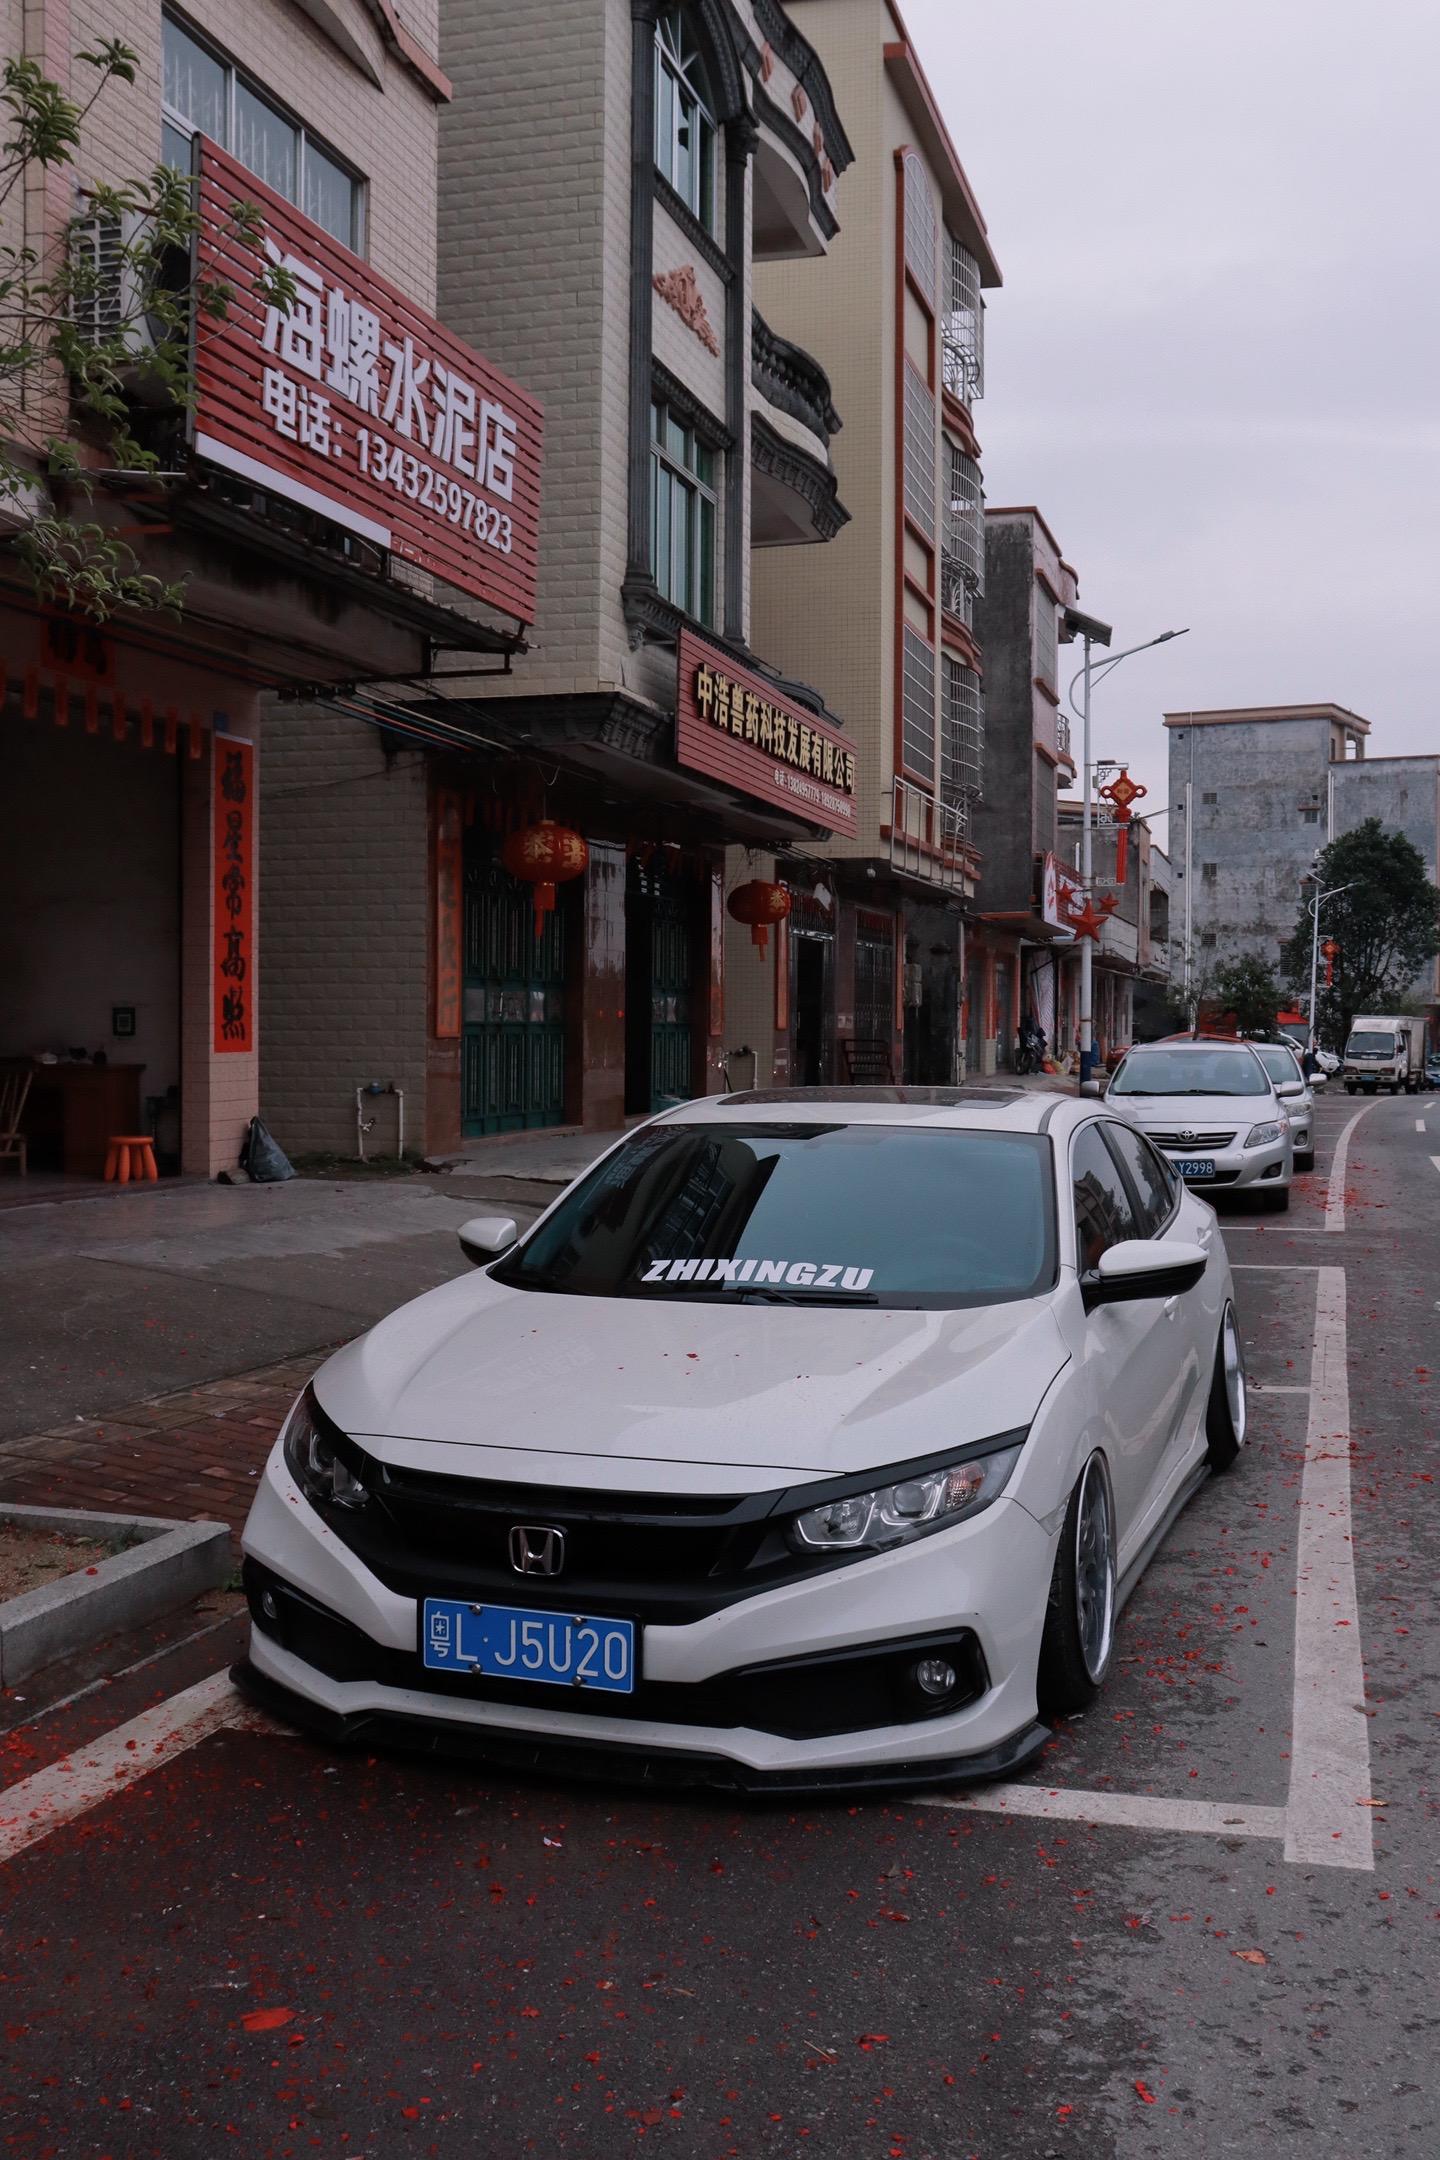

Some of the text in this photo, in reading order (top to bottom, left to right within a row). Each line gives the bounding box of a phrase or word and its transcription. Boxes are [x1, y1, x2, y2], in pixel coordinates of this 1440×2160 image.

[261, 234, 518, 503] 海螺水泥店
[696, 663, 856, 795] 中浩兽药科技发展有限公司
[641, 1258, 875, 1290] ZHIXINGZU
